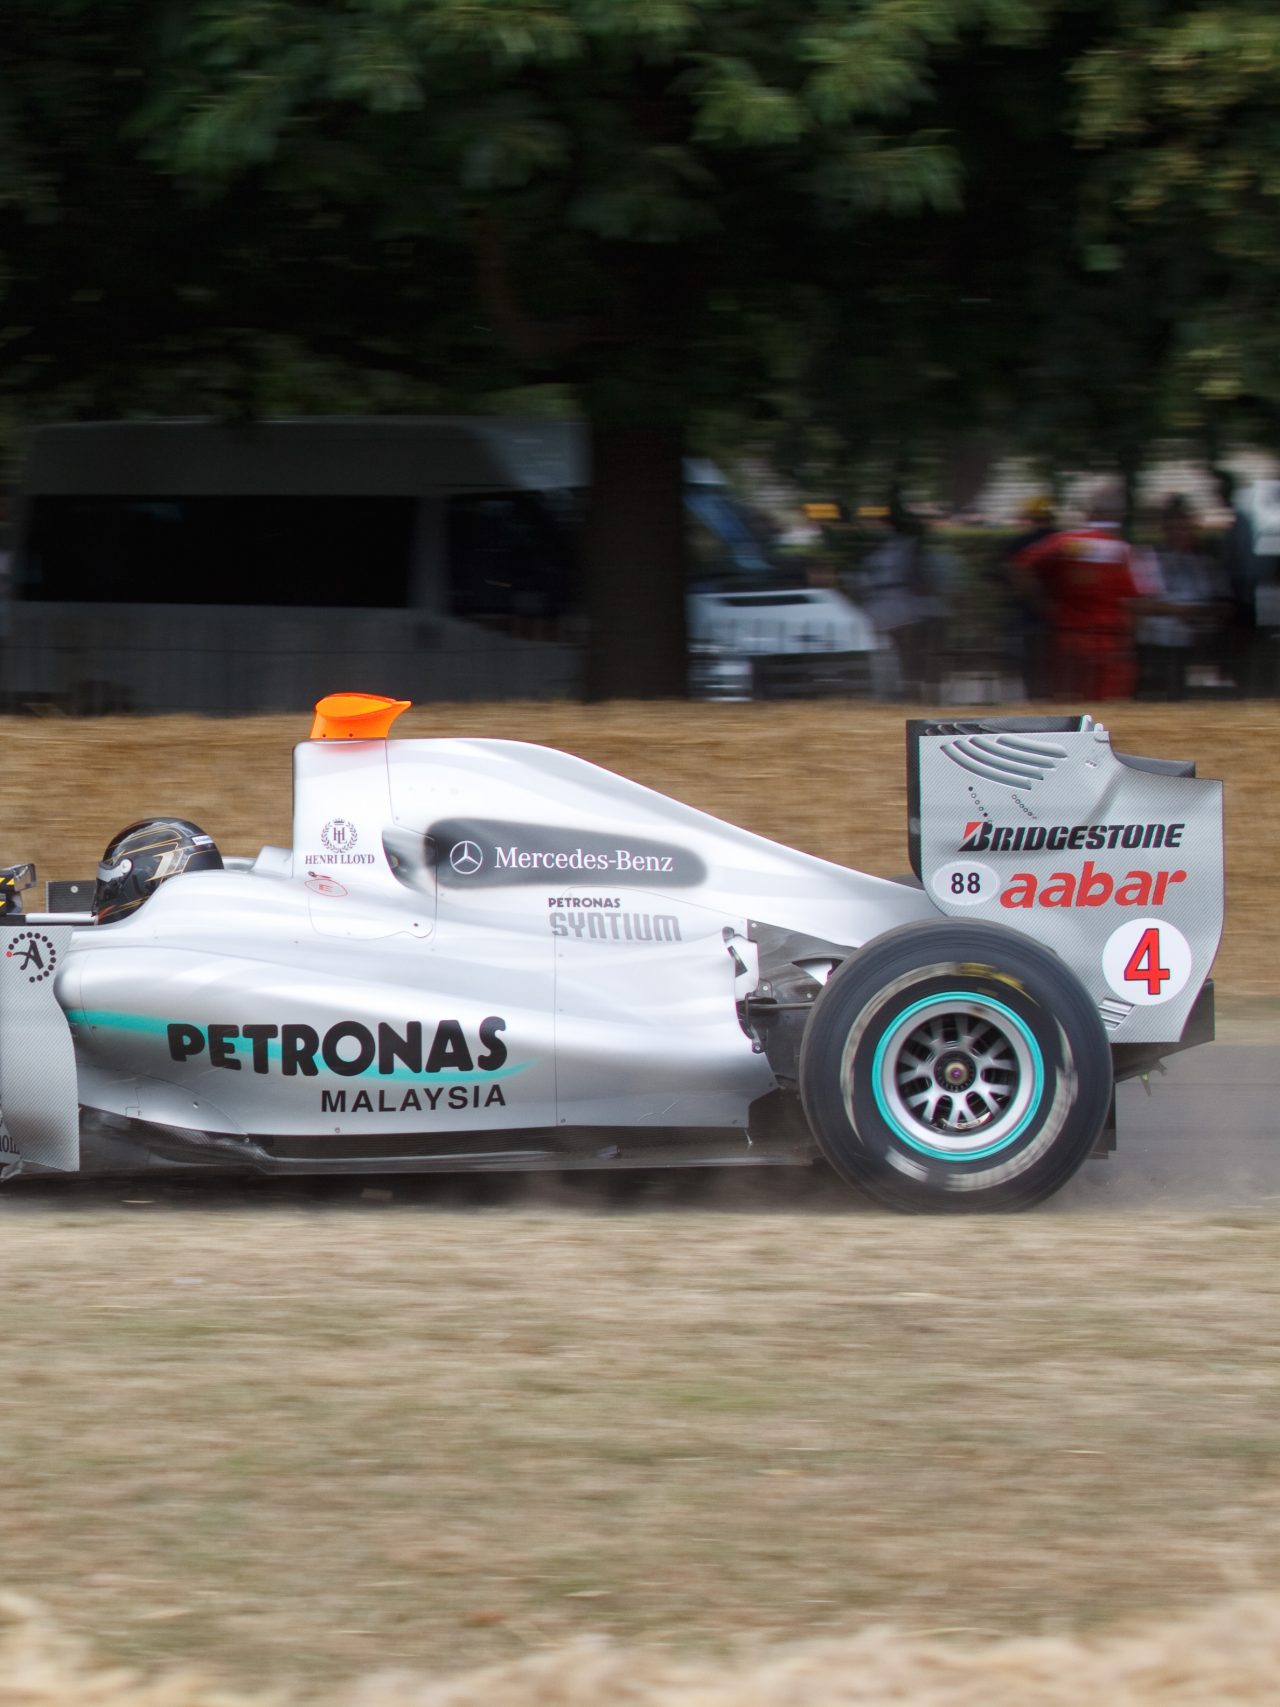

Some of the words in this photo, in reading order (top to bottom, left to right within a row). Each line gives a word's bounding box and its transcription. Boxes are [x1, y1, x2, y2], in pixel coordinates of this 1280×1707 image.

[958, 821, 1185, 852] BRIDGESTONE
[305, 854, 338, 865] HENRI
[340, 854, 375, 865] LLOYD
[494, 847, 673, 872] Mercedes-Benz
[950, 872, 981, 894] 88
[999, 861, 1187, 908] aabar
[548, 897, 621, 908] PETRONAS
[549, 912, 682, 942] SYNTIUM
[1123, 927, 1170, 995] 4
[167, 1016, 507, 1076] PETRONAS
[321, 1084, 506, 1113] MALAYSIA
